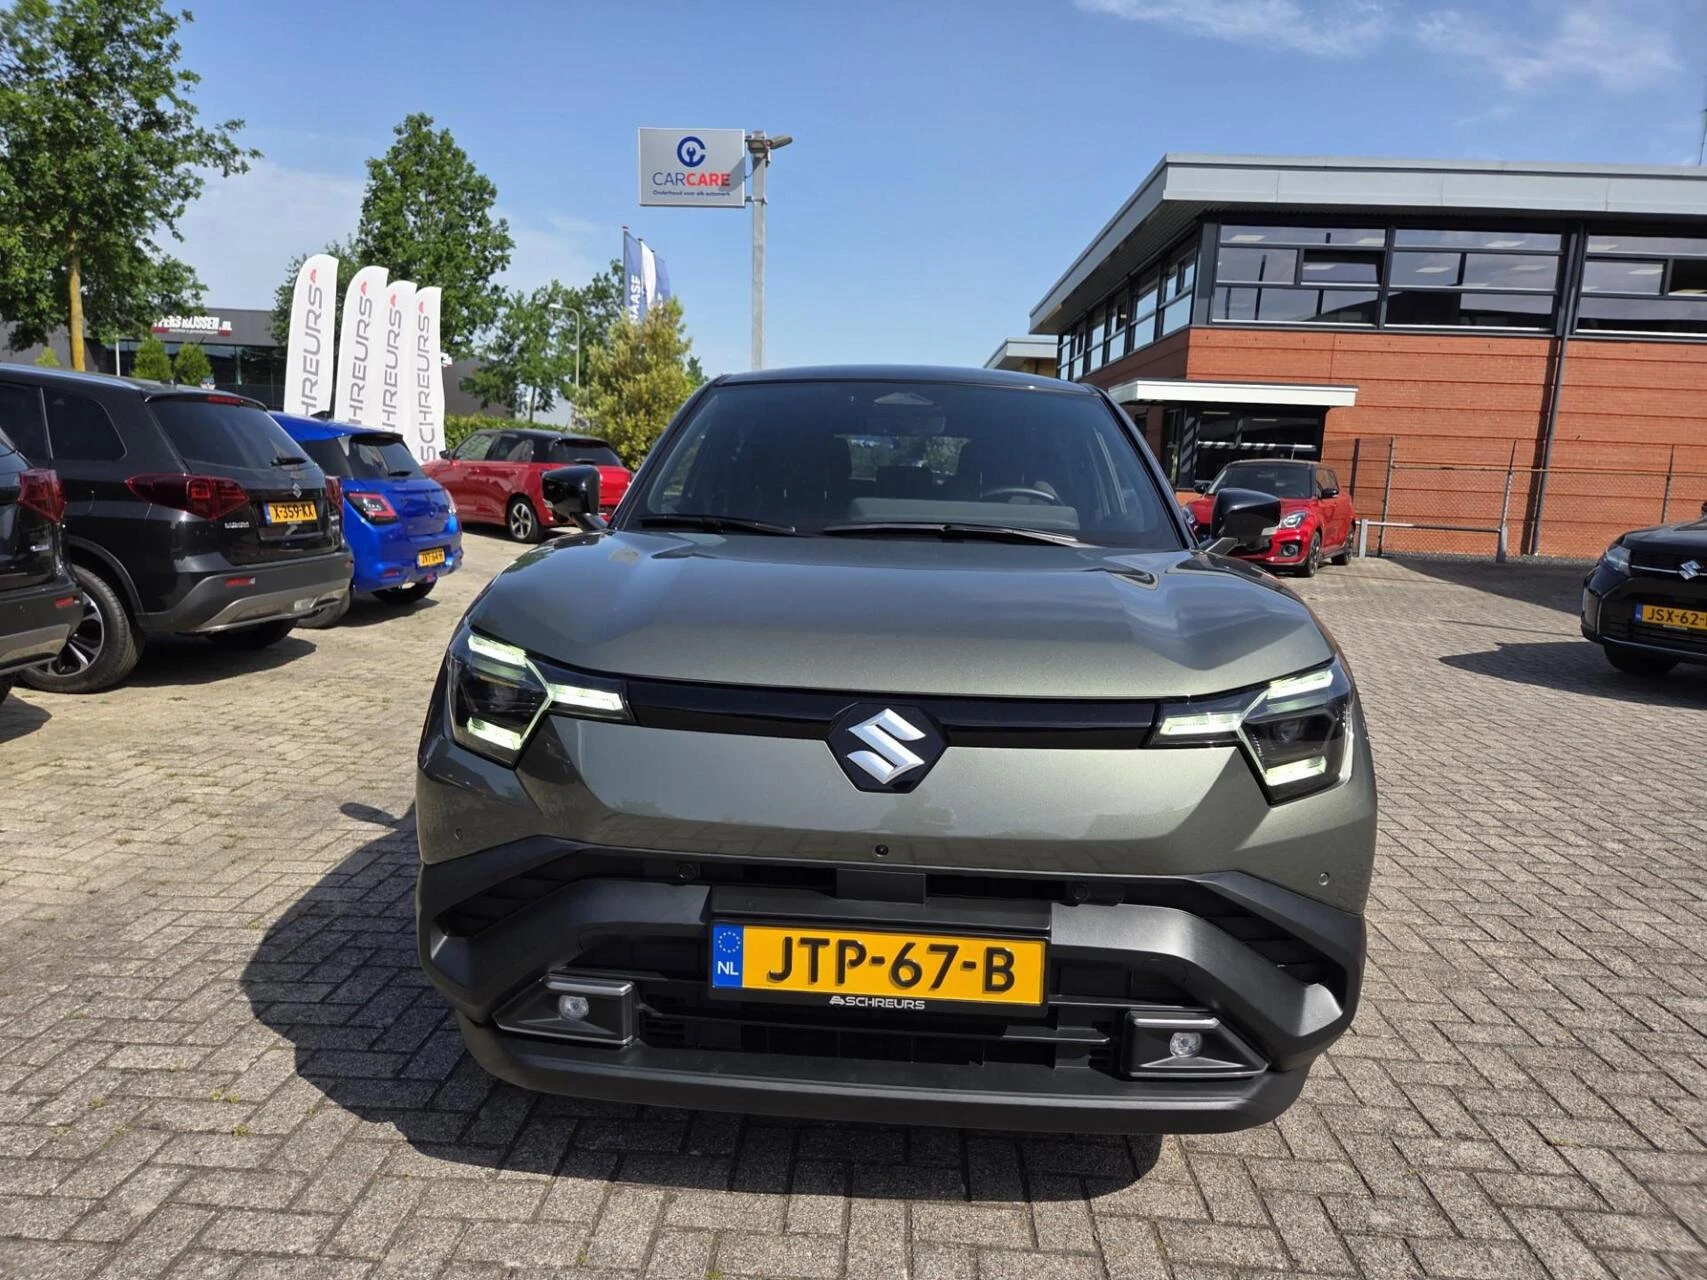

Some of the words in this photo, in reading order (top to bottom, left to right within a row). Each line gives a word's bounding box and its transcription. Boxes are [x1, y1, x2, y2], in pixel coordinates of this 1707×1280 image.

[652, 172, 731, 186] CARCARE
[300, 284, 323, 416] HREURS
[348, 296, 373, 425] HREURS
[382, 308, 402, 430] HREURS
[417, 314, 436, 462] SCHREURS
[1647, 607, 1707, 627] JSX-62-
[717, 961, 739, 977] NL
[767, 936, 1016, 993] JTP-67-B
[845, 996, 925, 1010] SCHREURS
